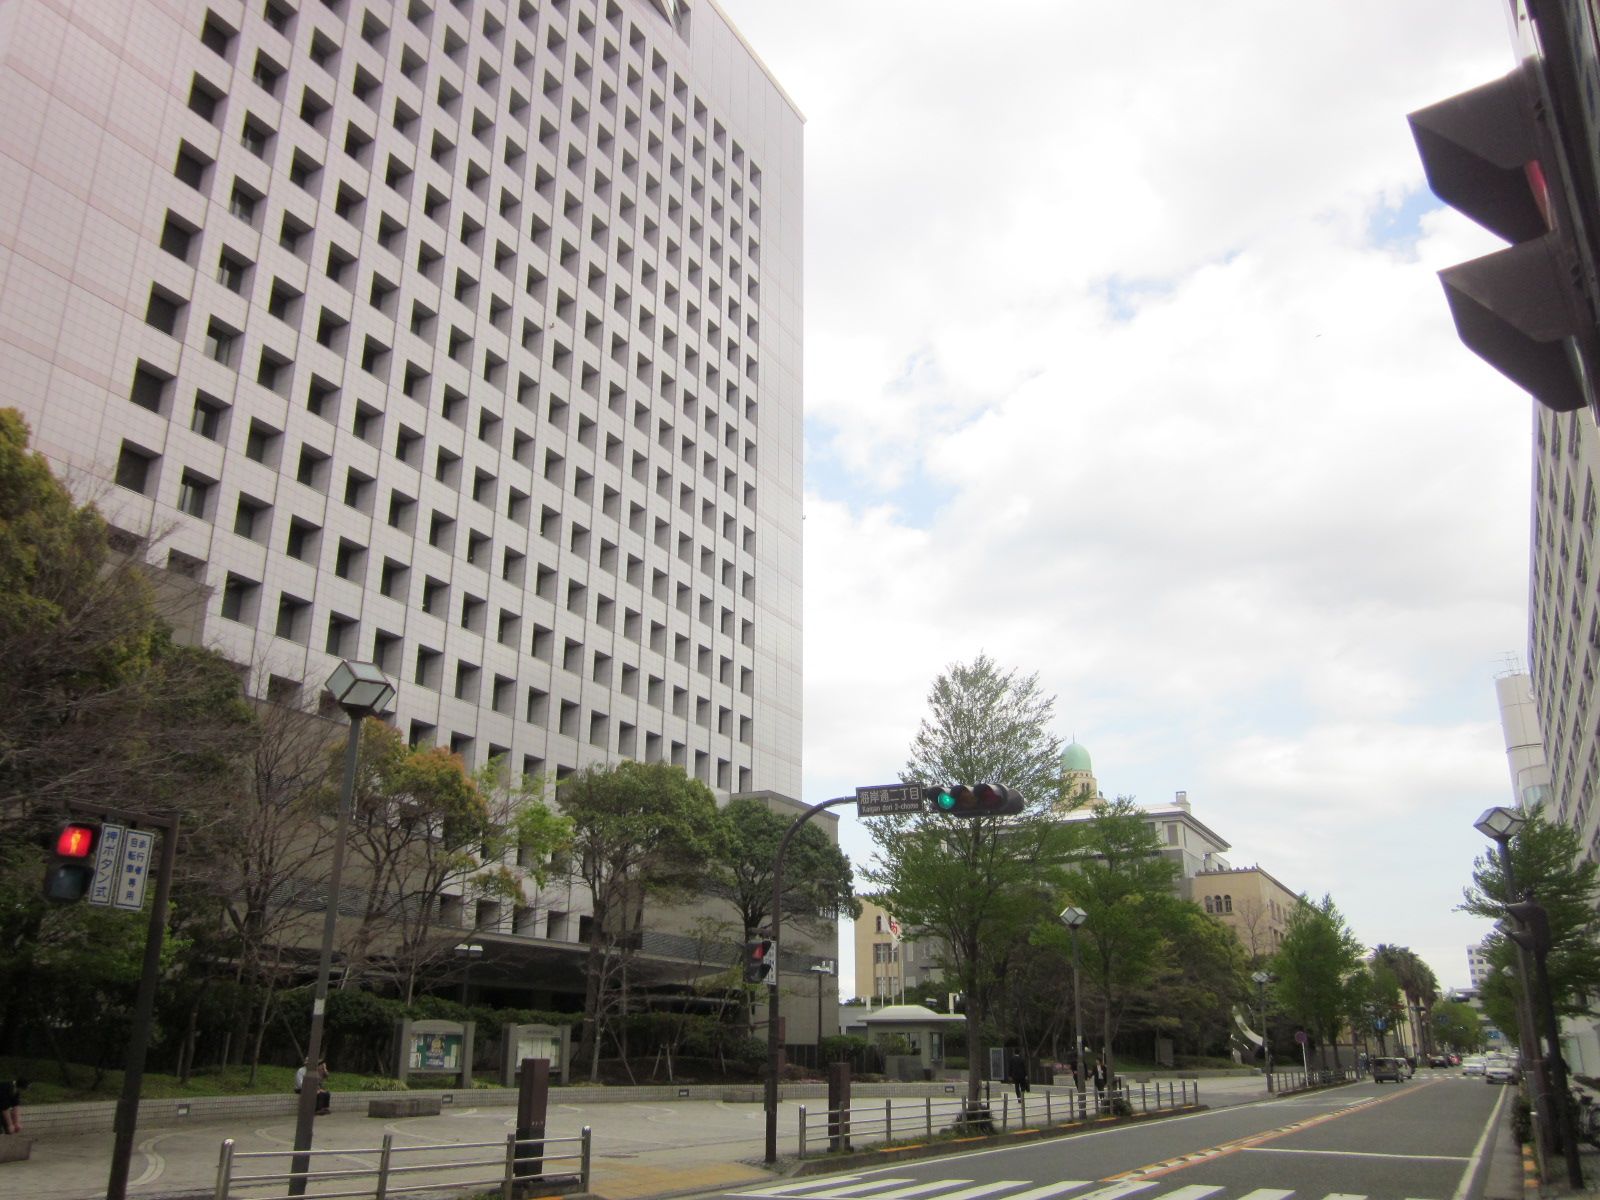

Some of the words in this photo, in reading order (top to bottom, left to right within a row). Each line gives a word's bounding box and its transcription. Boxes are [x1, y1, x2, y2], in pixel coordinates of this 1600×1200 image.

[860, 787, 919, 805] 海岸通二丁目
[95, 831, 118, 898] 押ボタン式
